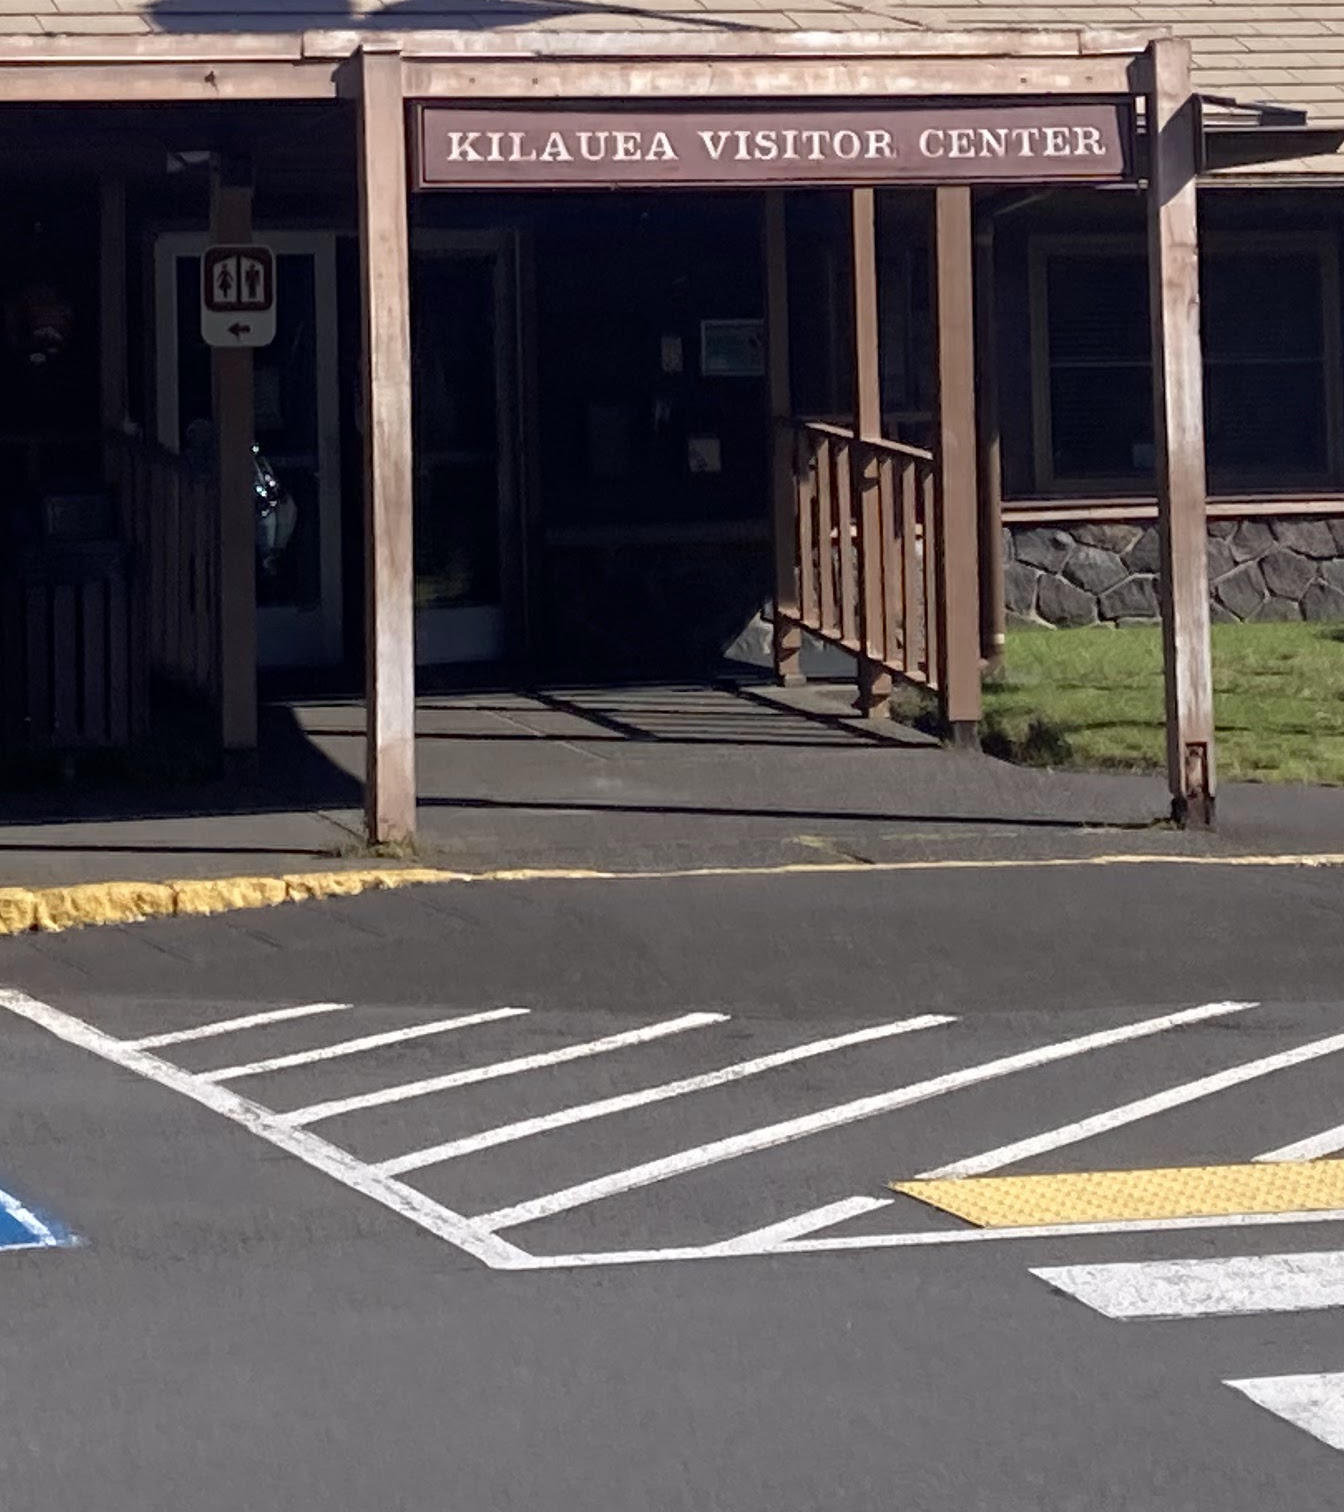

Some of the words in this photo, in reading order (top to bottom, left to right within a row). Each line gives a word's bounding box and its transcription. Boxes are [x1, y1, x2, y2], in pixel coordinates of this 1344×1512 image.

[447, 131, 679, 162] KILAUEA
[697, 129, 897, 160] VISITOR
[919, 127, 1106, 159] CENTER
